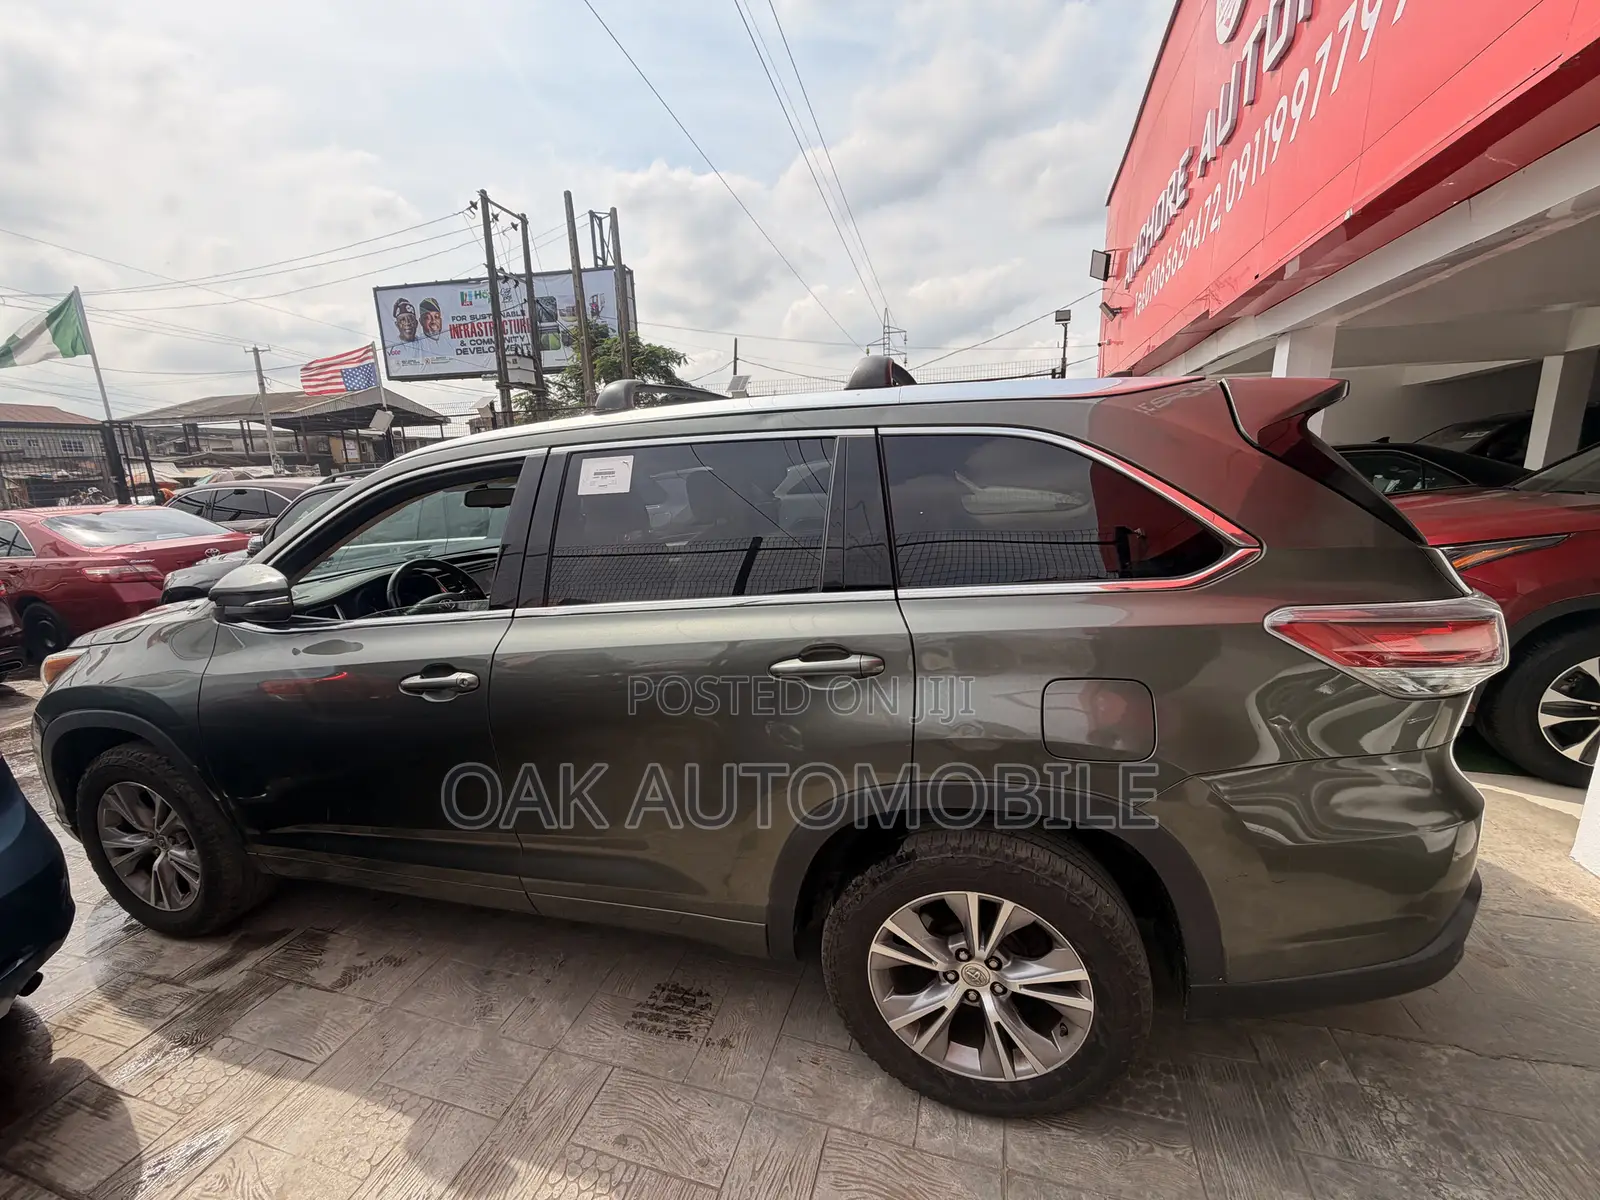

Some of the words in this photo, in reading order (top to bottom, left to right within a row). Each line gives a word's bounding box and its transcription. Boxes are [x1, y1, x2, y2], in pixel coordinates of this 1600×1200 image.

[1225, 0, 1407, 213] 091199779
[1124, 145, 1194, 290] ANCHORE
[1196, 0, 1313, 179] AUTO
[451, 314, 467, 322] FOR
[469, 310, 526, 320] SUSTNABLE
[449, 318, 532, 339] INFRASTRCTURE
[469, 335, 526, 346] COMMNITY
[455, 343, 531, 356] DEVELOMENT
